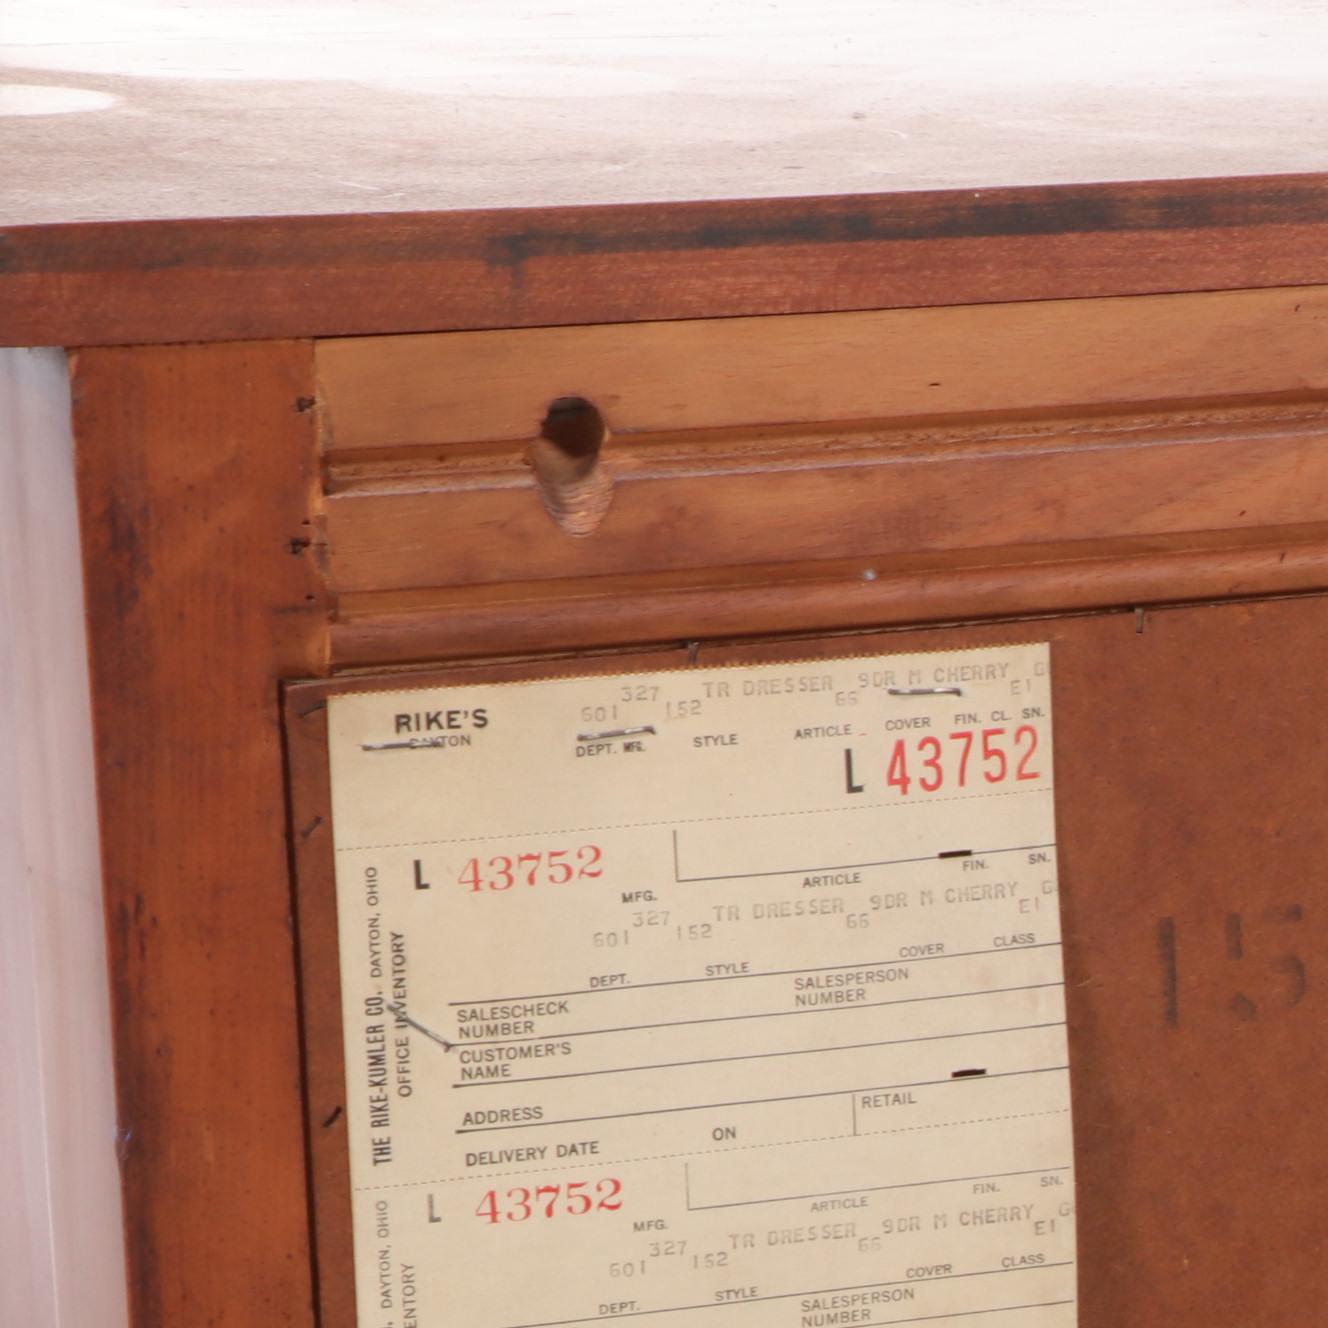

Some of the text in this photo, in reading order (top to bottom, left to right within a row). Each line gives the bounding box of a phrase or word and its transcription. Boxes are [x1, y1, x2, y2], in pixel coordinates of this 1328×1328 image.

[621, 685, 660, 703] 327
[702, 682, 730, 698] TR
[743, 674, 834, 698] DRESSER
[933, 662, 1010, 684] CHERRY
[395, 708, 489, 734] RIKE'S
[576, 743, 617, 758] DEPT.
[693, 734, 738, 748] STYLE
[794, 724, 852, 741] ARTICLE
[885, 716, 931, 732] COVER
[954, 711, 982, 725] FIN.
[1022, 706, 1046, 720] SN.
[845, 724, 1041, 795] L 43752
[364, 866, 379, 906] OHIO
[413, 844, 604, 893] L 43752
[621, 853, 1051, 904] MFG. ARTICLE FIN. SN.
[632, 910, 671, 928] 327
[712, 905, 740, 922] TR
[752, 897, 844, 920] DRESSER
[945, 881, 1018, 904] CHERRY
[676, 923, 712, 941] 152
[589, 933, 1035, 988] DEPT. STYLE COVER CLASS
[794, 968, 909, 991] SALESPERSON
[364, 991, 384, 1016] CO.
[390, 931, 412, 1097] OFFICE INVENTORY
[457, 1001, 569, 1023] SALESCHECK
[795, 988, 866, 1007] NUMBER
[458, 1021, 534, 1039] NUMBER
[459, 1042, 572, 1064] CUSTOMER'S
[366, 1023, 390, 1128] RIKE-KUMLER
[461, 1064, 511, 1081] NAME
[462, 1106, 544, 1126] ADDRESS
[861, 1093, 917, 1109] RETAIL
[372, 1136, 392, 1167] THE
[465, 1126, 736, 1167] DELIVERY DATE ON
[375, 1200, 391, 1238] OHIO
[427, 1177, 623, 1225] L 43752
[633, 1175, 1063, 1232] MFG. ARTICLE FIN. SN.
[649, 1240, 688, 1257] 327
[728, 1234, 755, 1250] TR
[767, 1222, 857, 1246] DRESSER
[959, 1203, 1035, 1227] CHERRY
[692, 1251, 729, 1269] 152
[599, 1253, 1046, 1315] DEPT. STYLE COVER CLASS
[801, 1288, 915, 1312] SALESPERSON
[801, 1309, 871, 1328] NUMBER
